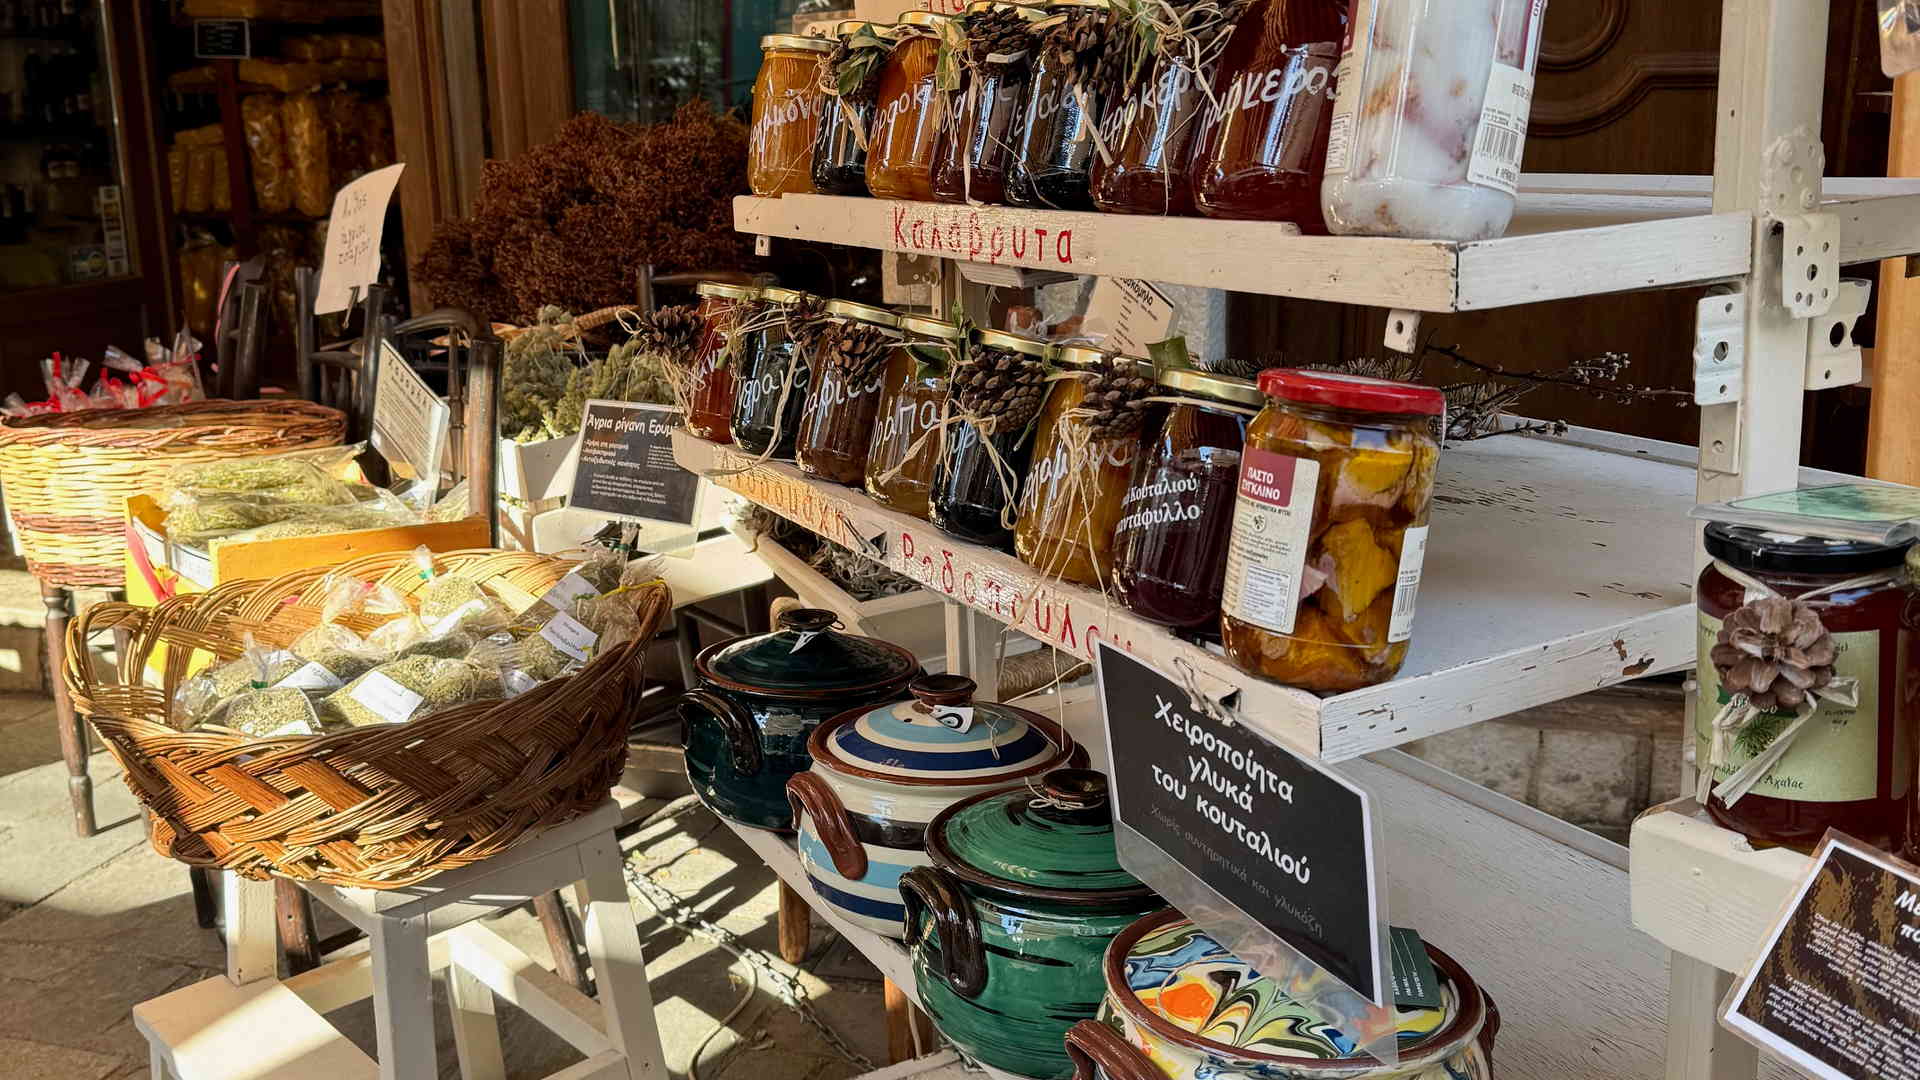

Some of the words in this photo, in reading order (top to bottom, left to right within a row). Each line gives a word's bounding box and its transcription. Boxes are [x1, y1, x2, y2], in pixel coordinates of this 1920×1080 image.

[615, 417, 646, 435] ρίγανη
[1153, 694, 1295, 805] Χειροποίητα
[1187, 755, 1254, 814] γλυκά
[1151, 764, 1187, 801] του
[1196, 795, 1311, 885] κουταλιού
[1252, 879, 1270, 898] και
[1275, 894, 1323, 939] γλυκόζη
